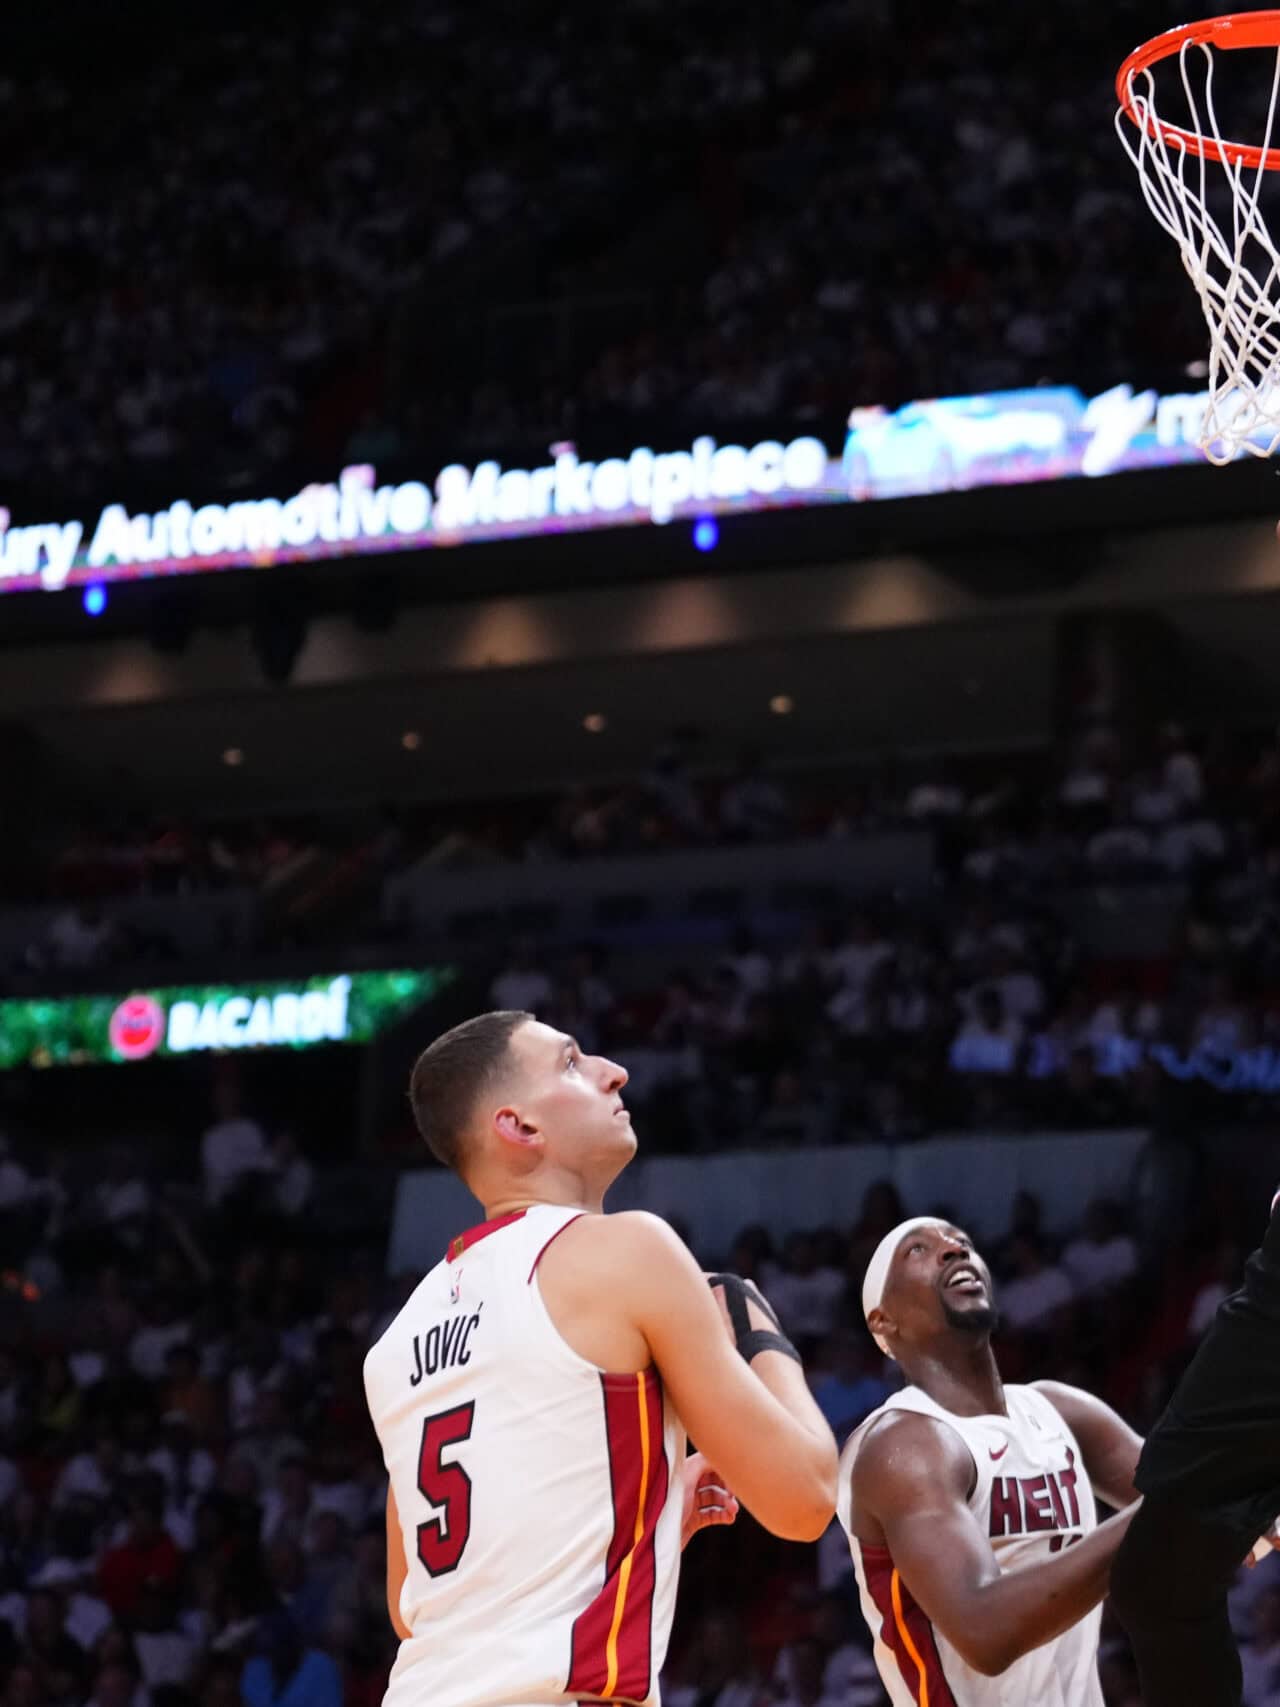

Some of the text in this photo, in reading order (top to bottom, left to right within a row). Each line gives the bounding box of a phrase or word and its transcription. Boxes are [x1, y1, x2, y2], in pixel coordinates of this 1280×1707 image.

[87, 468, 431, 566] Automotive
[434, 436, 828, 527] Marketplace
[410, 1301, 484, 1387] JOVIĆ
[417, 1399, 475, 1578] 5
